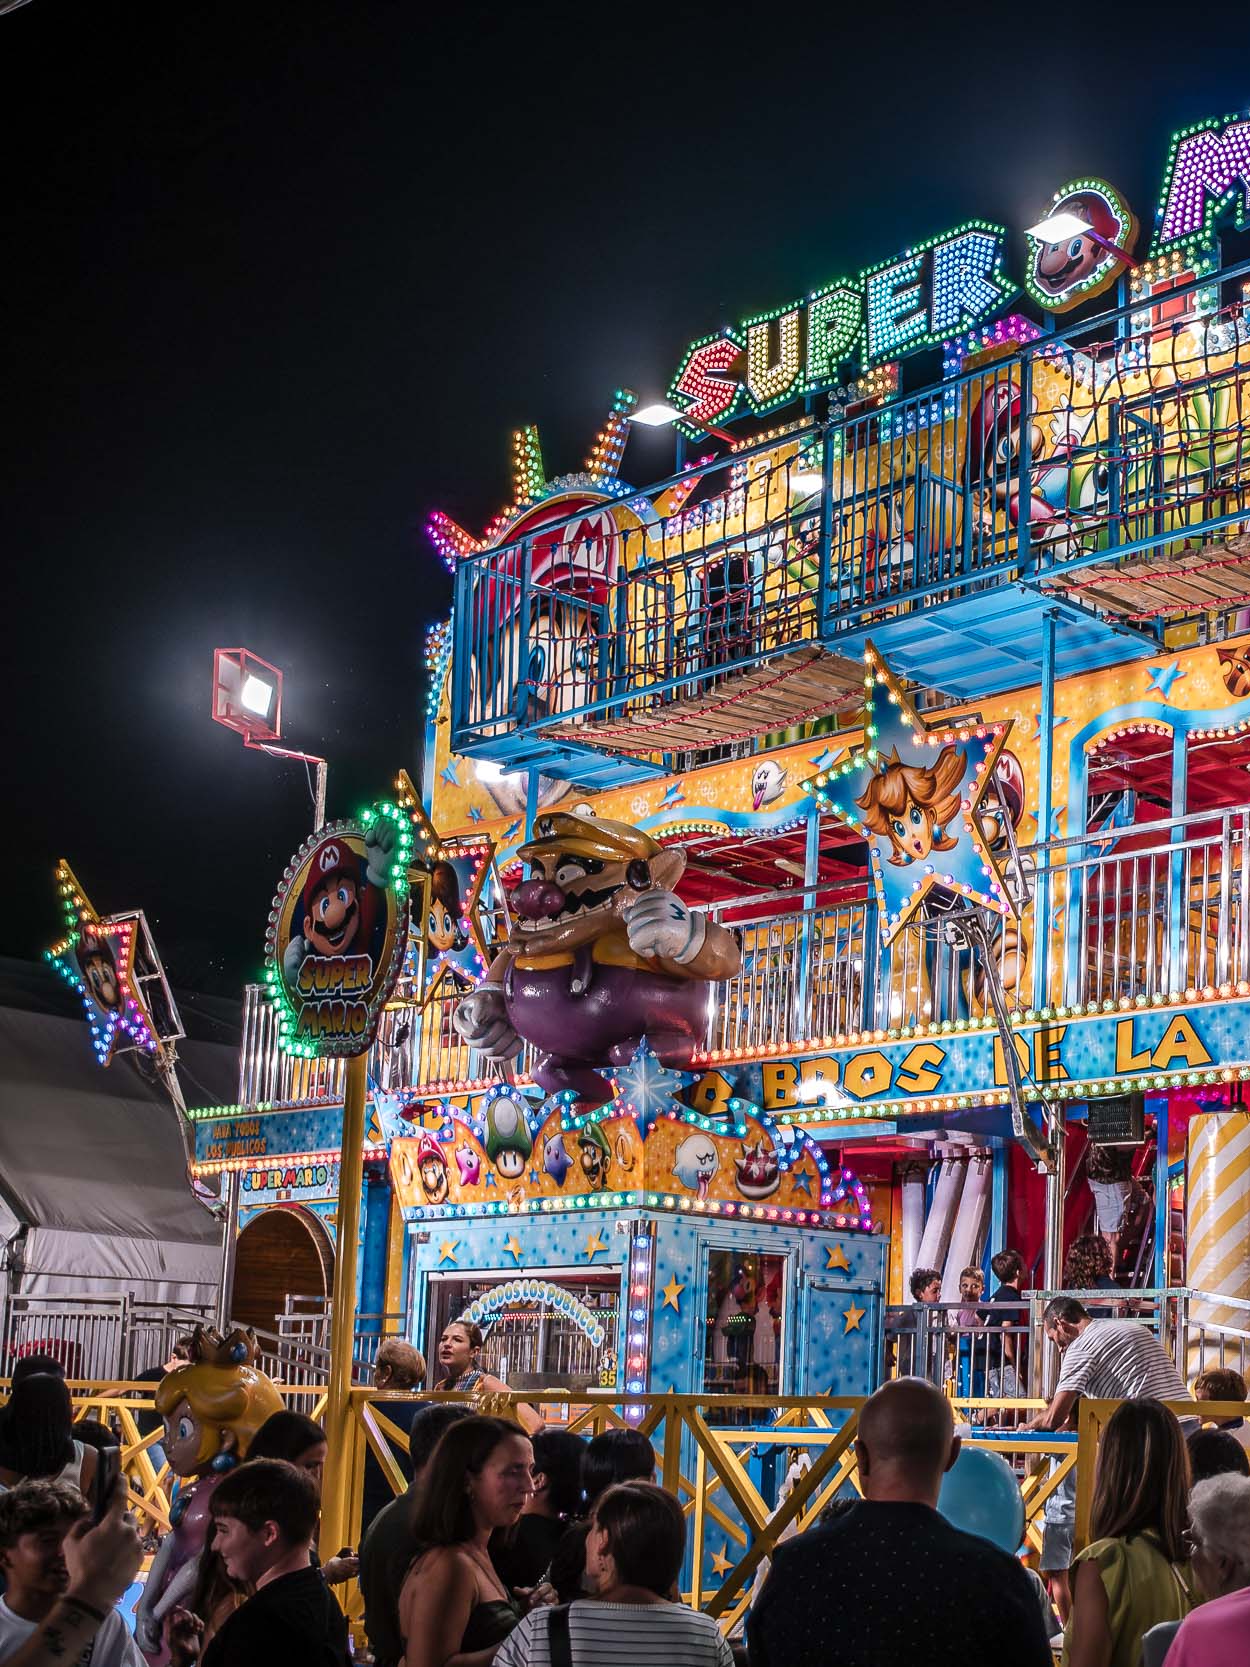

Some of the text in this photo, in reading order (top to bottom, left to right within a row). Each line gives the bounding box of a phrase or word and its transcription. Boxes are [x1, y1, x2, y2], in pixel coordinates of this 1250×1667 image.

[672, 228, 1005, 418] SUPER
[295, 953, 373, 996] SUPER
[294, 1000, 369, 1040] MARIO
[762, 1043, 946, 1110] BROS
[993, 1025, 1070, 1086] DE
[1115, 1014, 1213, 1074] LA
[243, 1165, 328, 1192] SUPER MARIO
[480, 1283, 521, 1312] TODOS
[522, 1281, 545, 1299] LOS
[546, 1285, 603, 1345] PUBLICOS
[600, 1369, 617, 1386] 35
